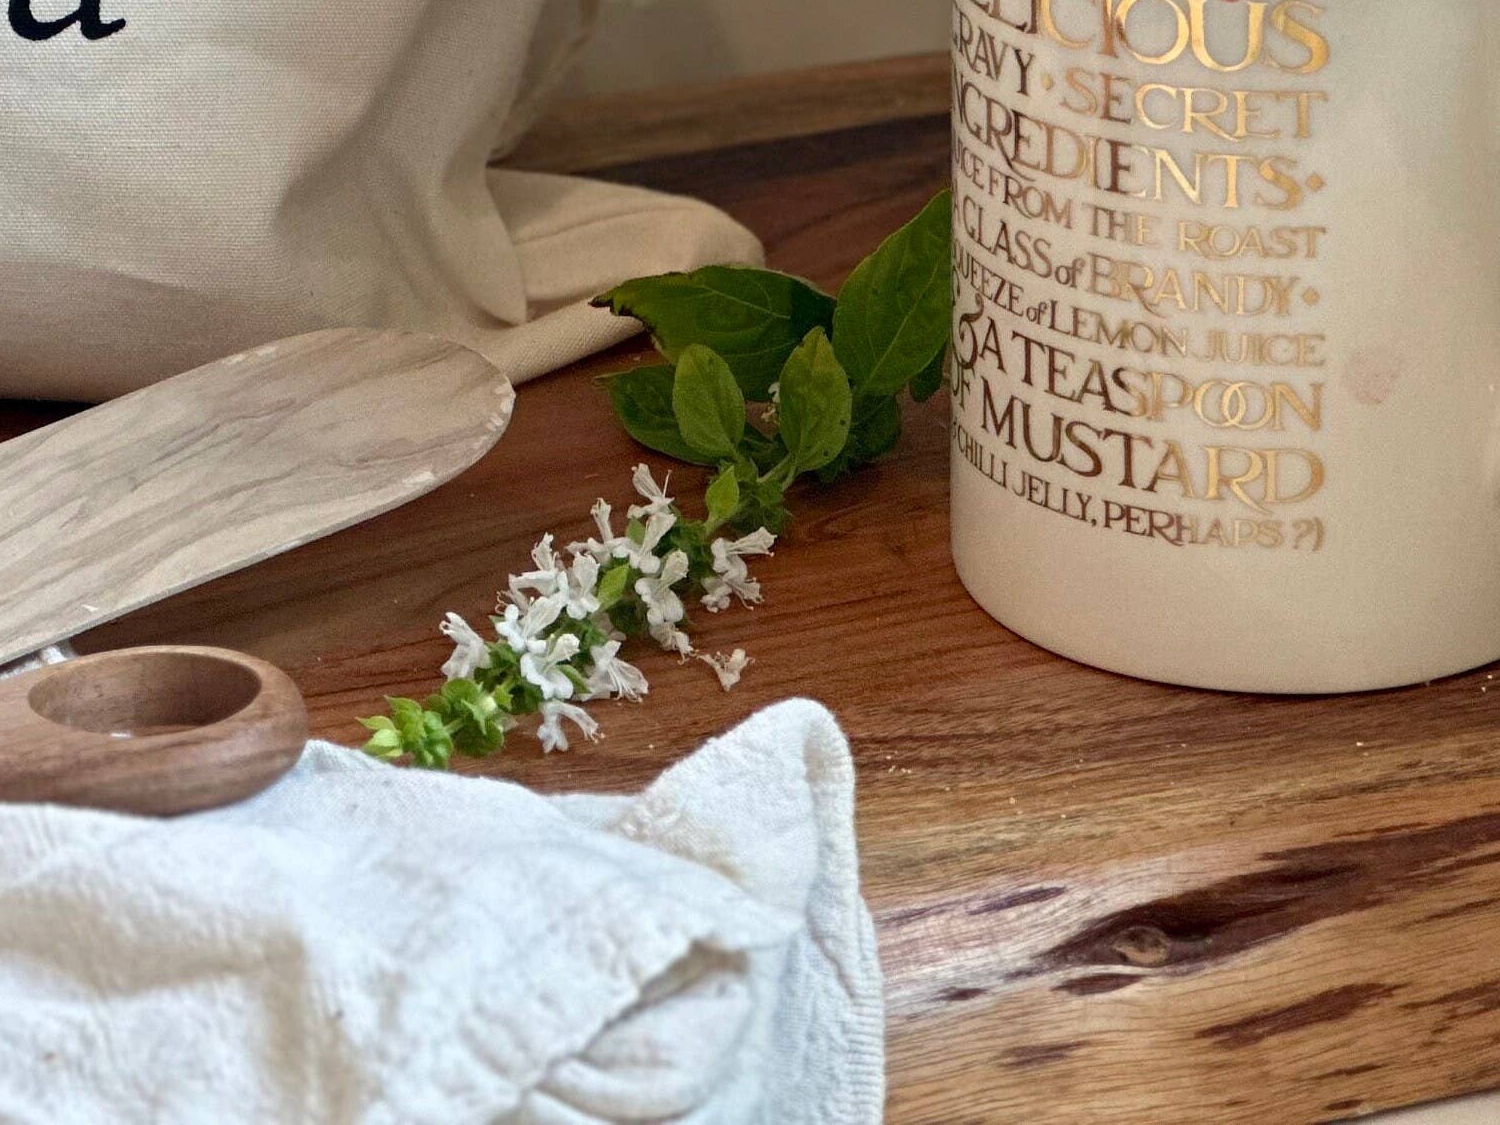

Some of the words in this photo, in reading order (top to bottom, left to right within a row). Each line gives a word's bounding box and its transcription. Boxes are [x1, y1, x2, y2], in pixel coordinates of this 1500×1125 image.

[1060, 66, 1330, 143] SECRET
[962, 194, 1053, 280] GLASS
[1054, 257, 1086, 290] of
[1085, 251, 1302, 318] BRANDY
[987, 164, 1073, 230] FROM
[1082, 203, 1159, 247] THE
[1177, 219, 1327, 261] ROAST
[1010, 329, 1325, 432] TEASPOON
[1026, 301, 1048, 325] of
[1048, 298, 1189, 358] LEMON
[1192, 328, 1327, 367] JUICE
[957, 424, 1008, 489] CHILLI
[1011, 470, 1098, 528] JELLY,
[980, 375, 1326, 515] MUSTARD
